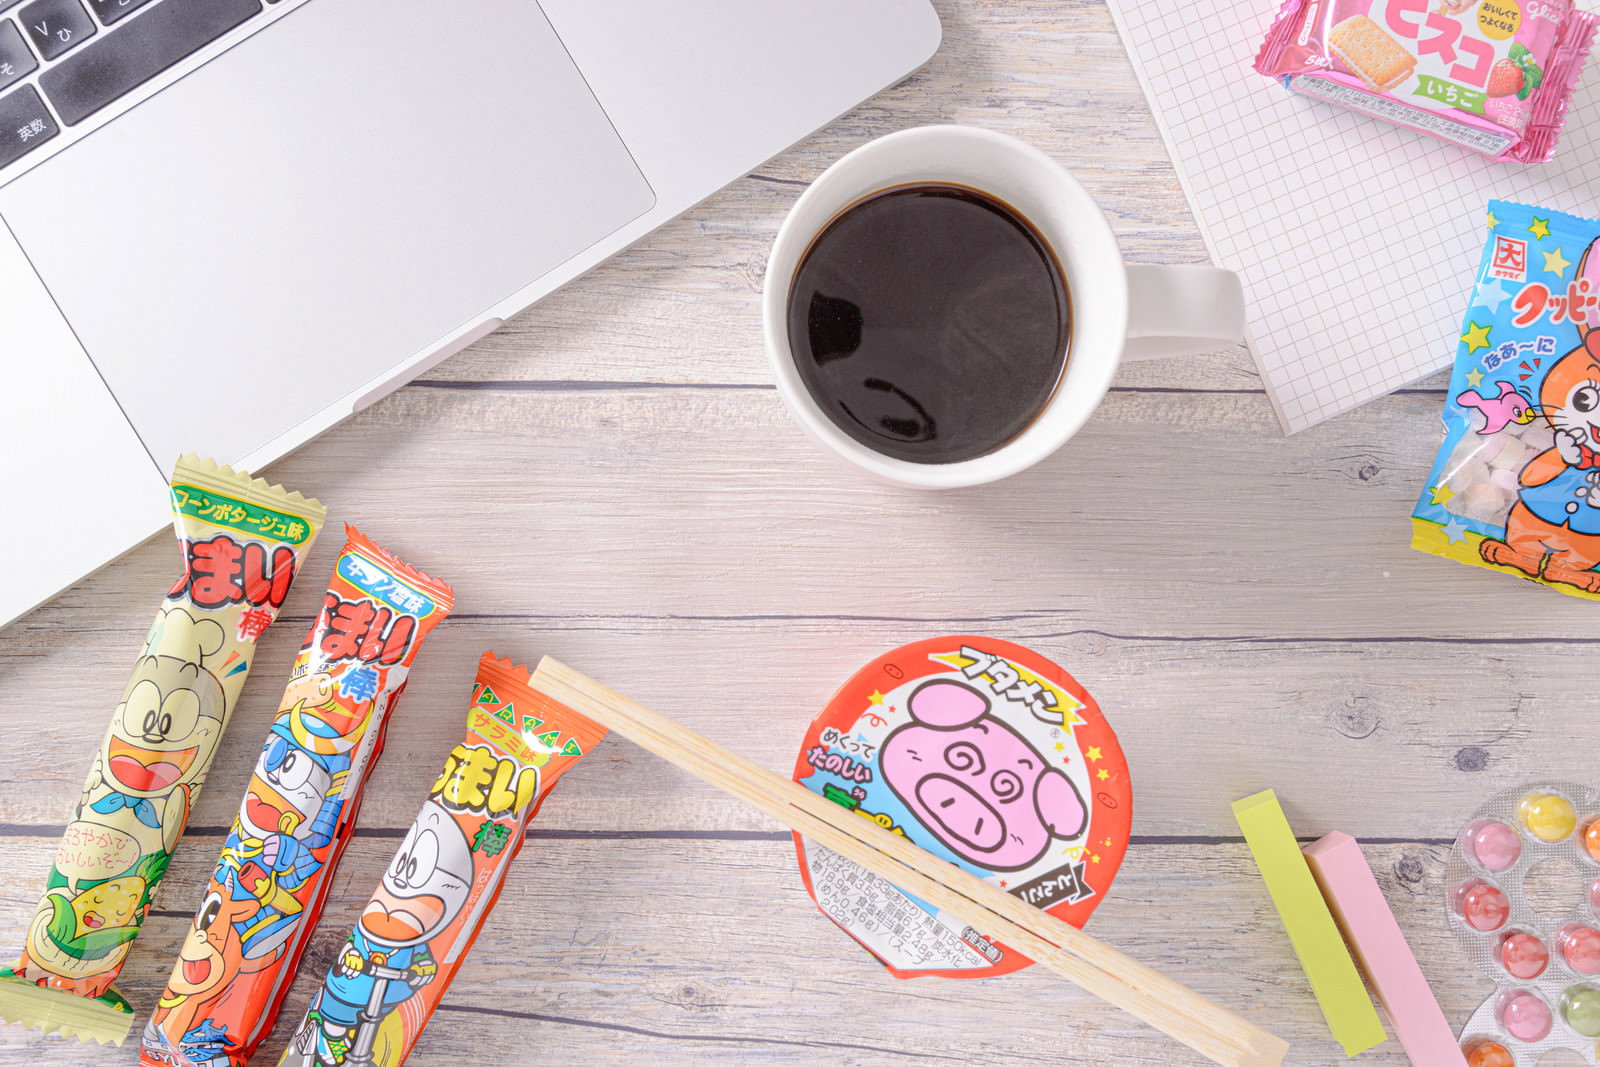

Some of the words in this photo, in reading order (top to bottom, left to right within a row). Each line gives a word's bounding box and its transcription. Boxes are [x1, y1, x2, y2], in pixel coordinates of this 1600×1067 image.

[1480, 15, 1514, 33] つよくなる
[1482, 2, 1518, 21] おいしくて
[34, 21, 48, 36] V
[57, 28, 72, 42] ひ
[1427, 80, 1478, 108] いちご
[17, 118, 47, 142] 英数
[1513, 281, 1600, 326] クッピー
[173, 488, 305, 541] コーンポタージュ味
[960, 644, 1064, 726] ブタメン
[474, 713, 537, 762] サラミ味
[823, 729, 876, 759] めくって
[808, 746, 872, 783] たのしい
